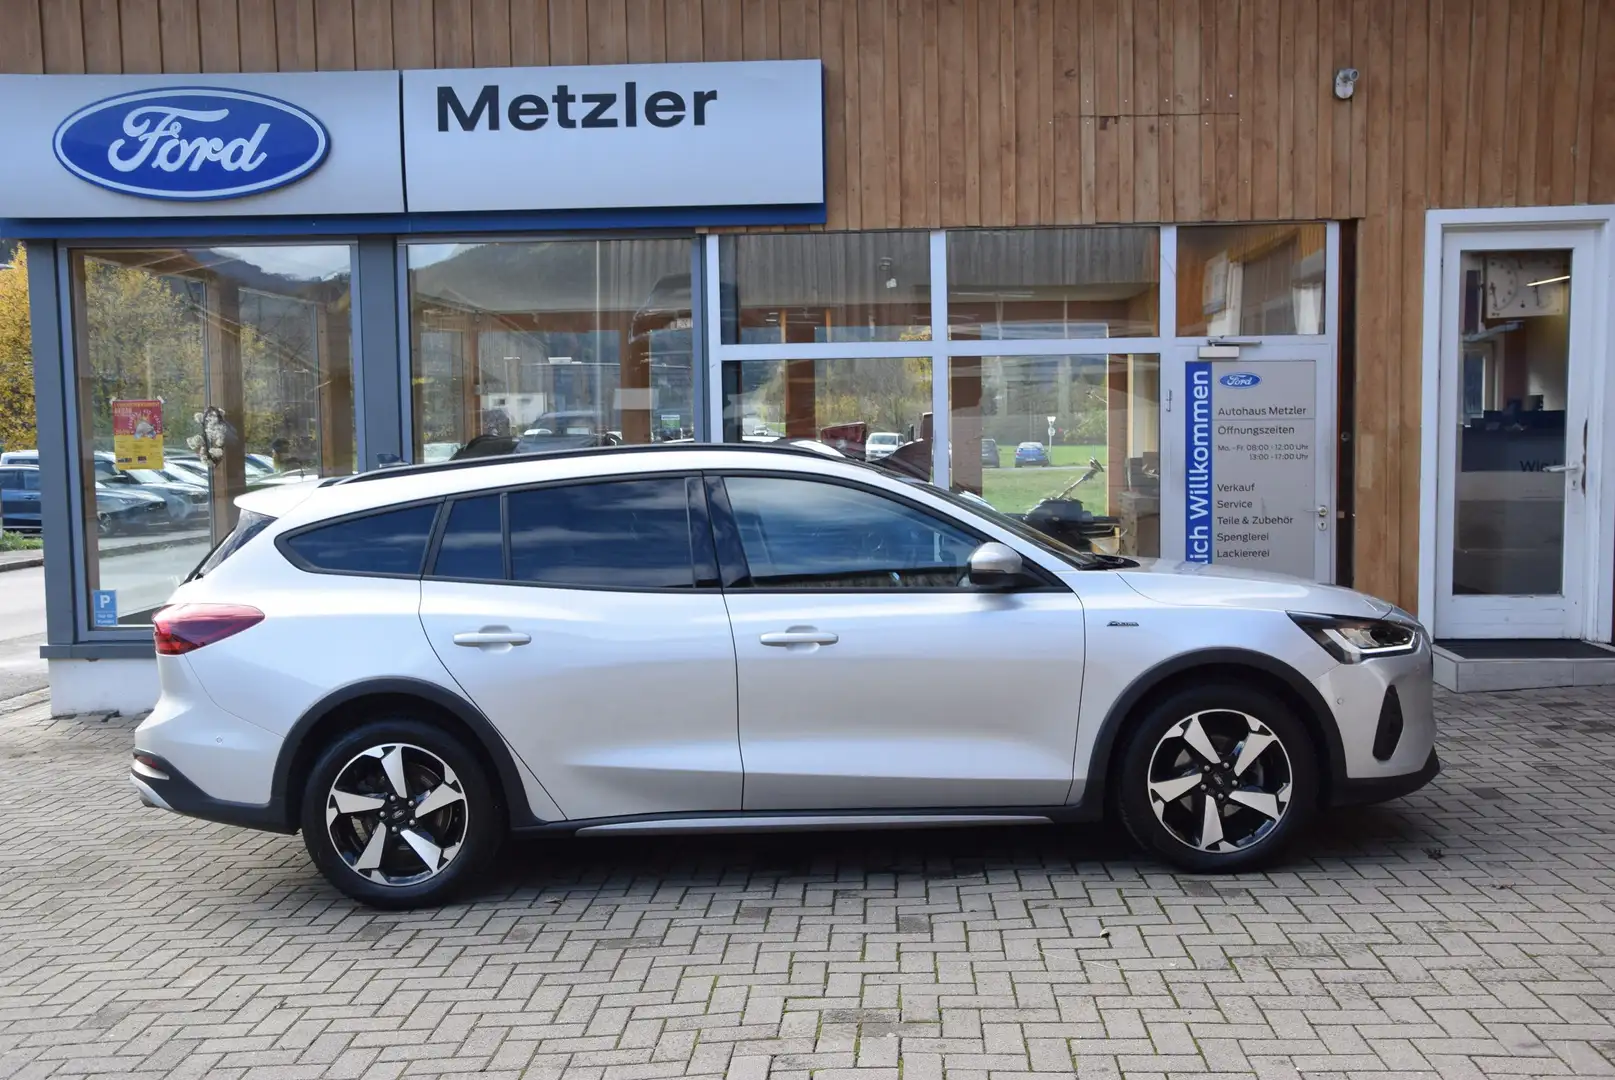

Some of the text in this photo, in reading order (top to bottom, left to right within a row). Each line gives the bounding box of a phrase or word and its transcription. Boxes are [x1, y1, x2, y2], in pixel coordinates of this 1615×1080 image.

[437, 82, 717, 132] Metzler
[108, 105, 271, 172] Ford
[1227, 374, 1253, 386] Ford
[1218, 406, 1307, 416] Autohaus Metzler
[1189, 371, 1209, 564] ich Willkommen
[1217, 483, 1255, 492] Verkauf
[1217, 500, 1253, 509] Service
[1217, 515, 1294, 525] Teile & Zubehör
[1217, 532, 1269, 543] Spenglerei
[1217, 549, 1270, 558] Lackiererei
[100, 595, 110, 608] P
